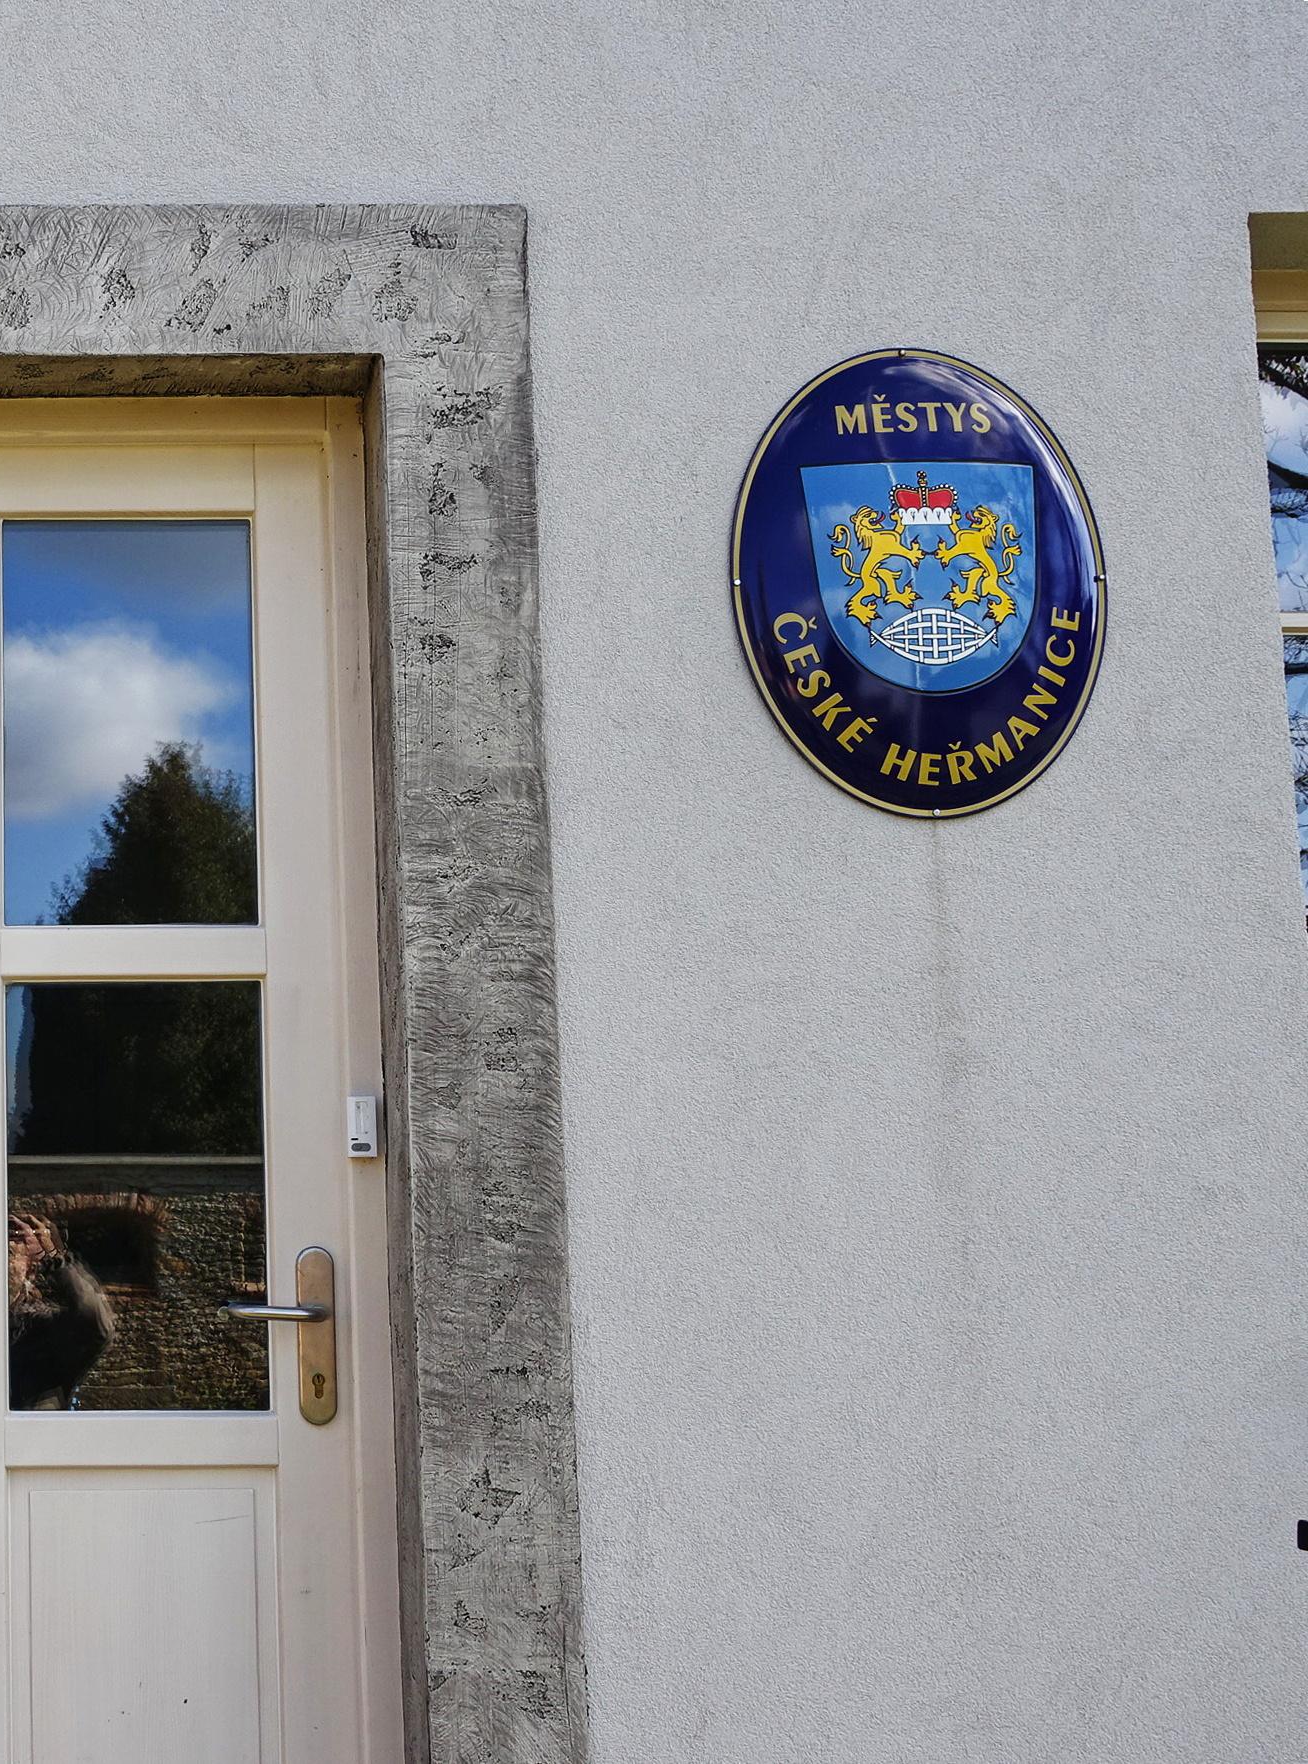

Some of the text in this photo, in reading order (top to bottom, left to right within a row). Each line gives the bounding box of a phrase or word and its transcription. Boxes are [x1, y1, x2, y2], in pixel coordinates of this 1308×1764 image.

[834, 394, 992, 435] MĚSTYS
[772, 605, 1080, 786] ČESKÉ HEŘMANICE
